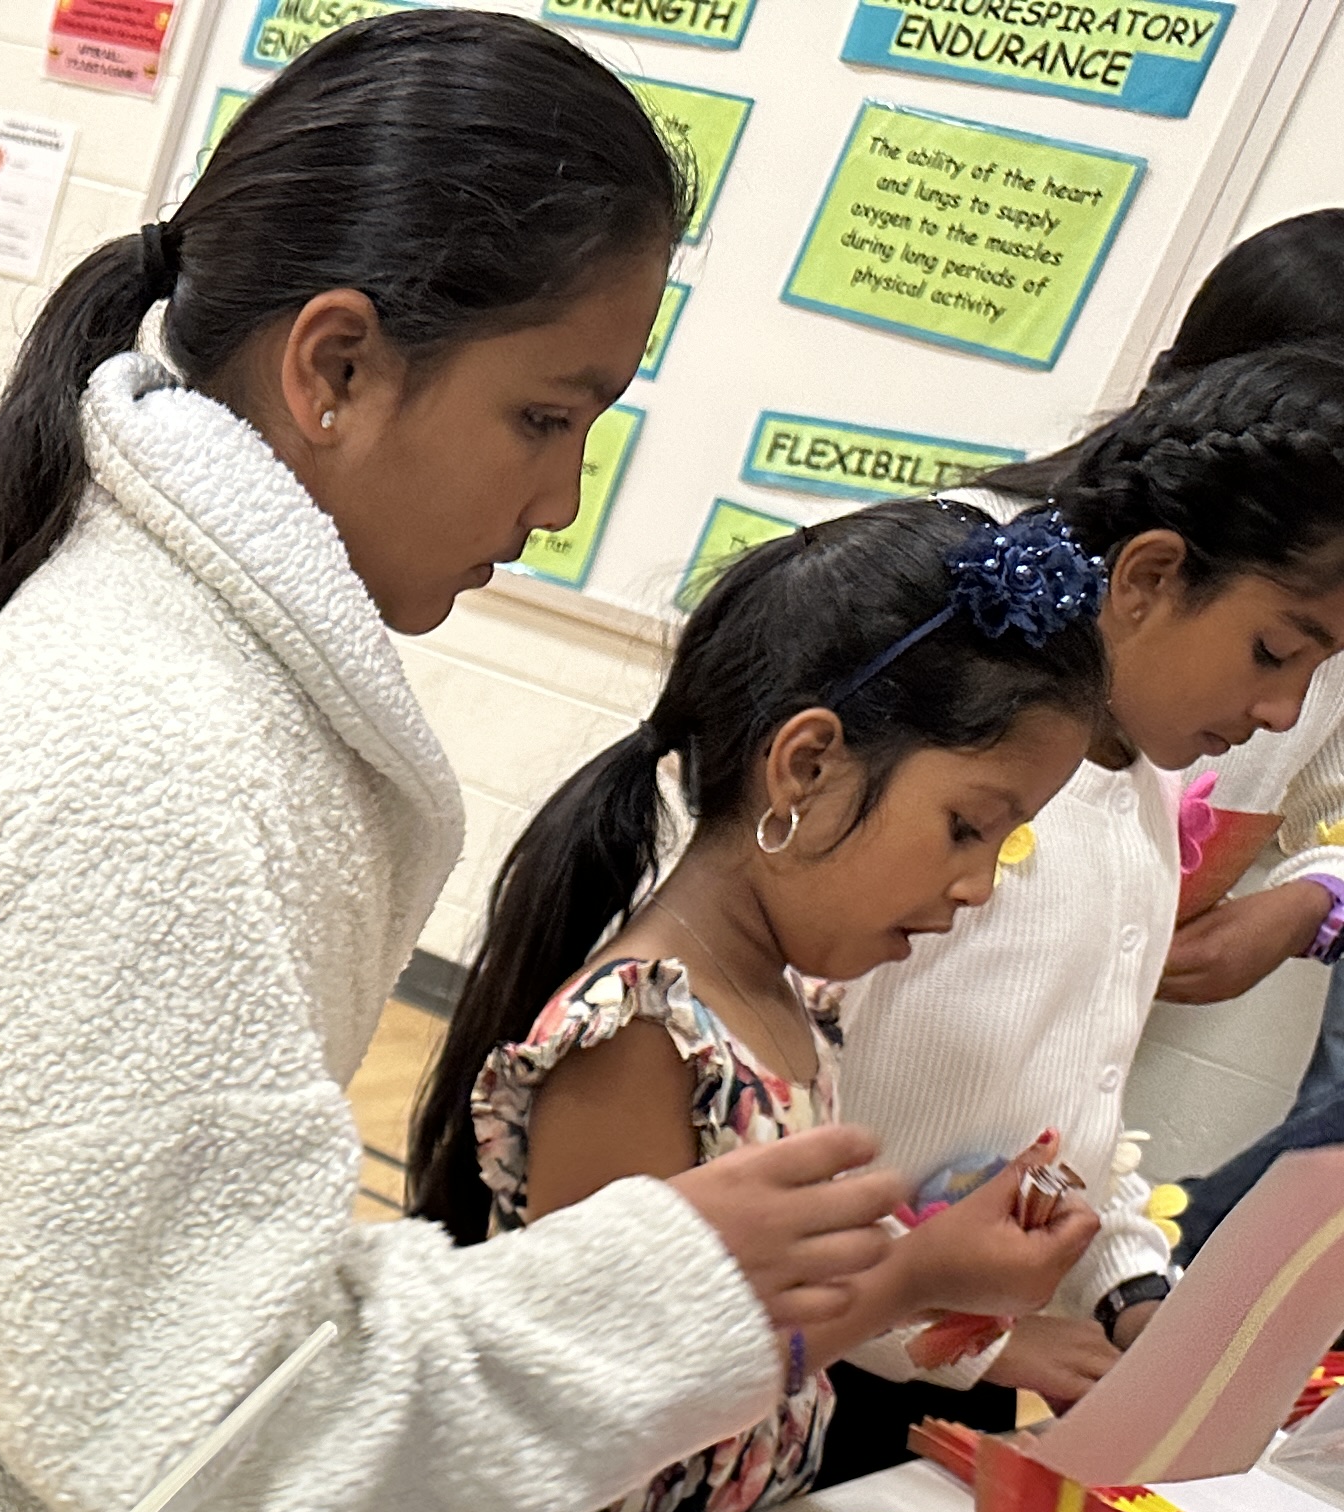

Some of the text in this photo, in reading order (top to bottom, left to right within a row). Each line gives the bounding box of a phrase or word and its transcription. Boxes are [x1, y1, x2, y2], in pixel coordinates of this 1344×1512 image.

[894, 14, 1133, 87] ENDURANCE
[870, 136, 1103, 206] The ability of the heart
[851, 202, 1062, 266] oxygen to the muscles
[877, 175, 1060, 236] and lungs to supply
[841, 230, 1051, 296] during long periods of
[851, 267, 1007, 323] physical activity
